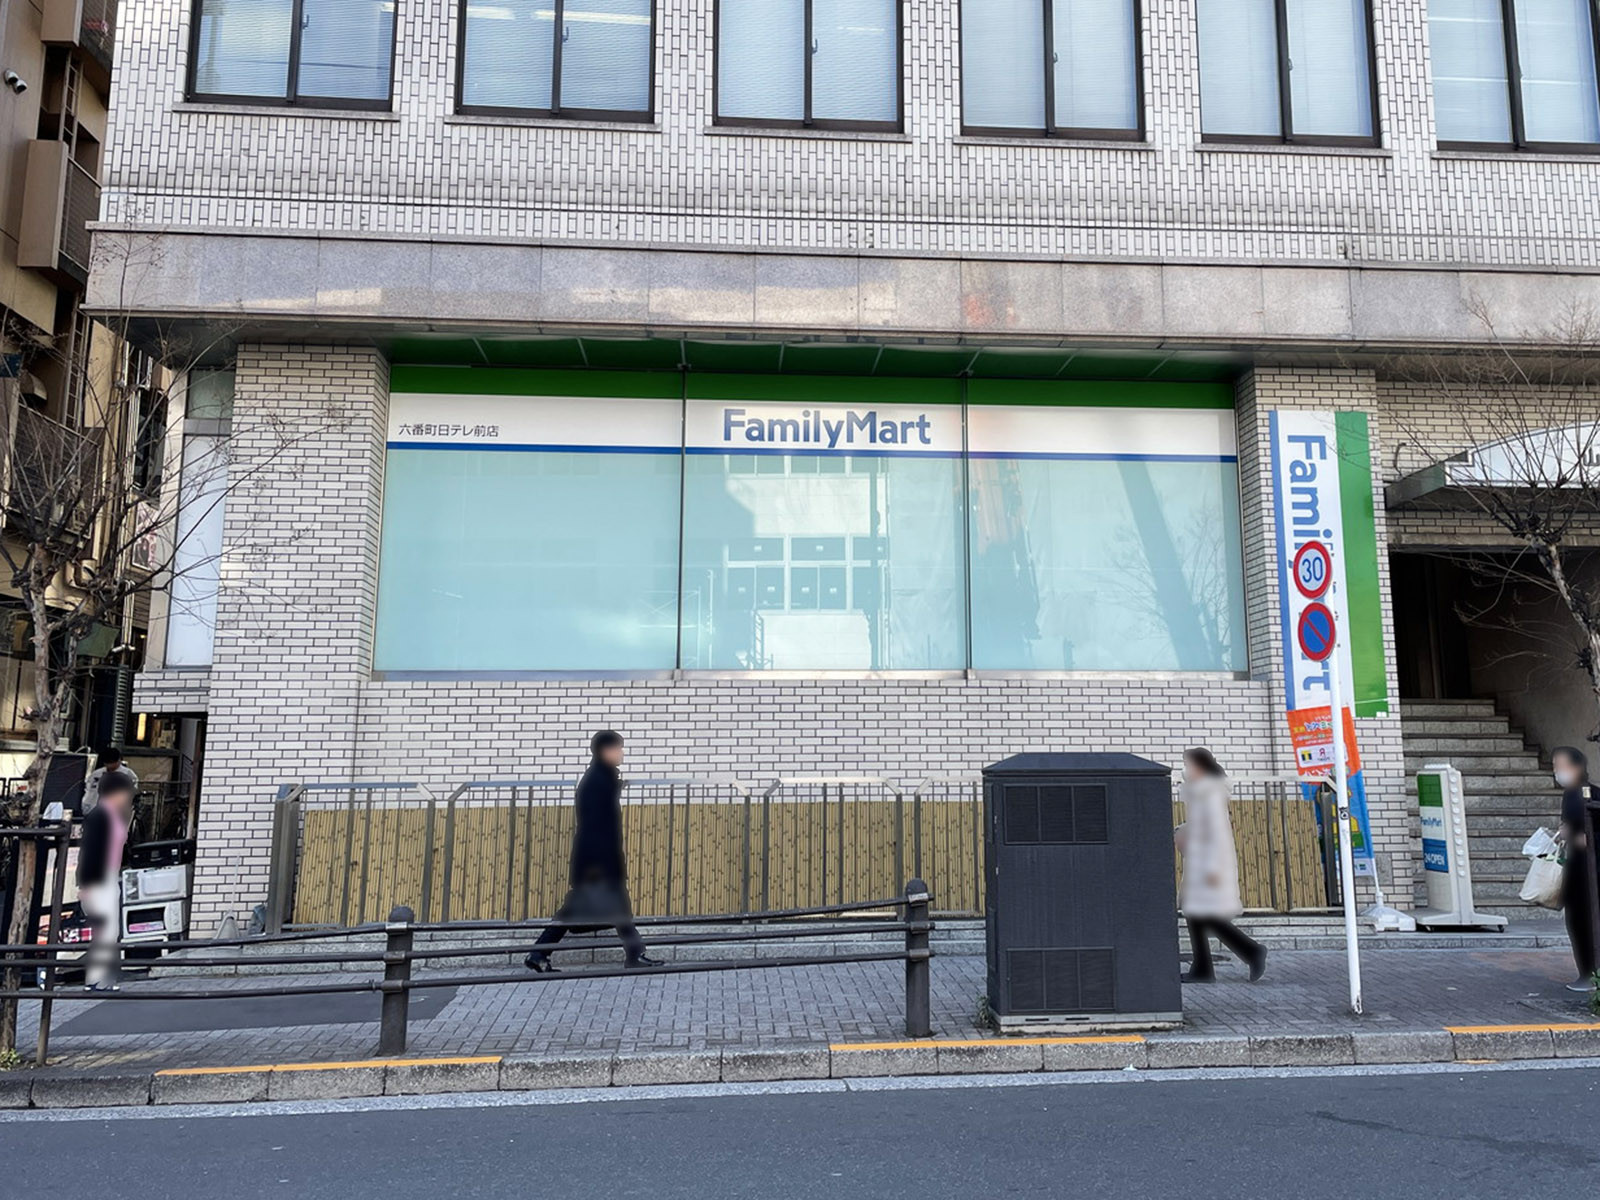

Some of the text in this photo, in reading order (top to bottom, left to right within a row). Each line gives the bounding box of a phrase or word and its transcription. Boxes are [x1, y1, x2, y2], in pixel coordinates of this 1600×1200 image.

[398, 423, 499, 437] 六番町日テレ前店
[723, 408, 931, 449] FamilyMart
[1301, 556, 1323, 583] 30
